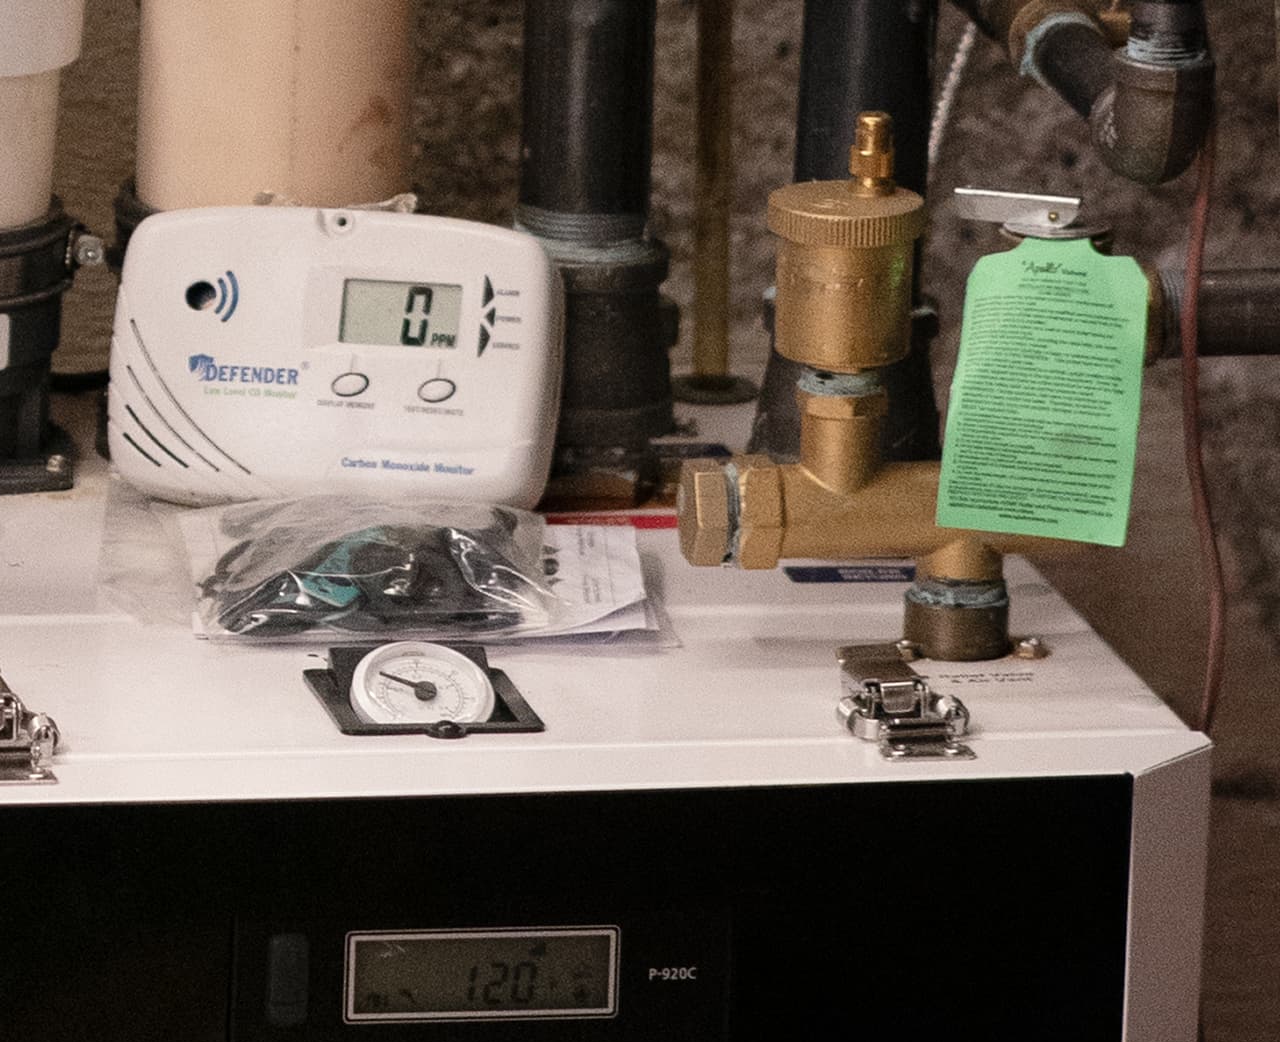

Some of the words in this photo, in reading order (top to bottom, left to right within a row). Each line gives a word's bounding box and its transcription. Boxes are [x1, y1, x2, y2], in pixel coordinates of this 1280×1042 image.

[400, 286, 434, 347] 0
[430, 332, 457, 347] PPM
[205, 363, 299, 385] DEFENDER
[341, 457, 377, 468] Carbon
[381, 459, 430, 472] Monoxide
[433, 463, 475, 475] Monitor
[467, 960, 538, 1004] 120
[648, 966, 697, 980] P-920C
